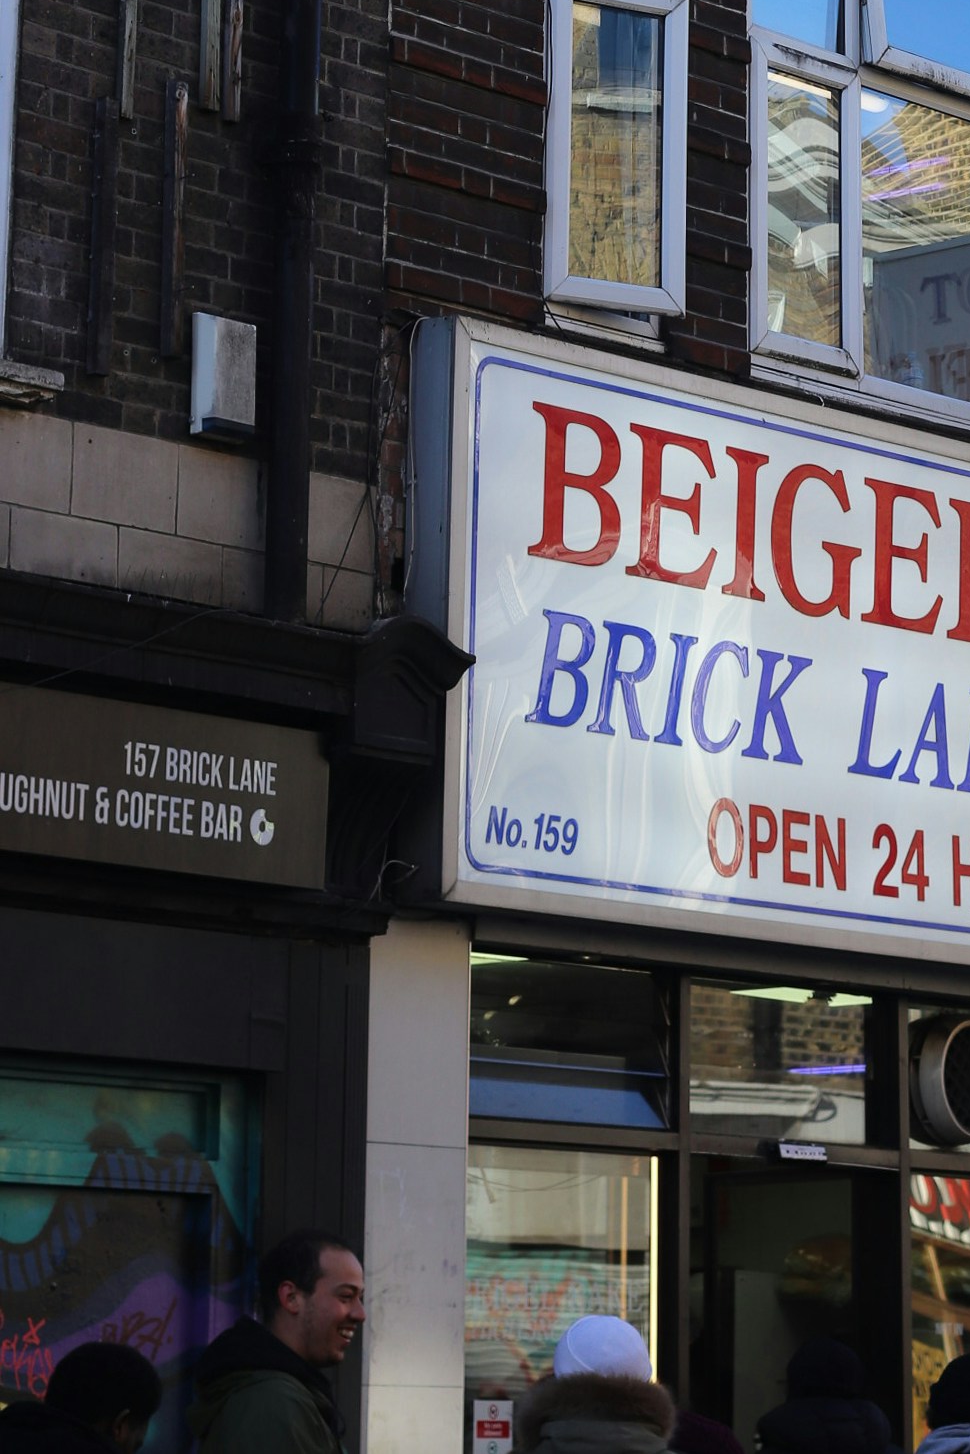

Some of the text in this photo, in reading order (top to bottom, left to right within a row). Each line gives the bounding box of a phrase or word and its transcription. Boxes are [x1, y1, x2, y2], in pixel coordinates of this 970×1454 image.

[524, 608, 813, 767] BRICK
[0, 772, 243, 843] UGHNUT & COFFEE BAR
[124, 741, 278, 796] 157 BRICK LANE
[708, 797, 847, 892] OPEN
[872, 822, 930, 903] 24
